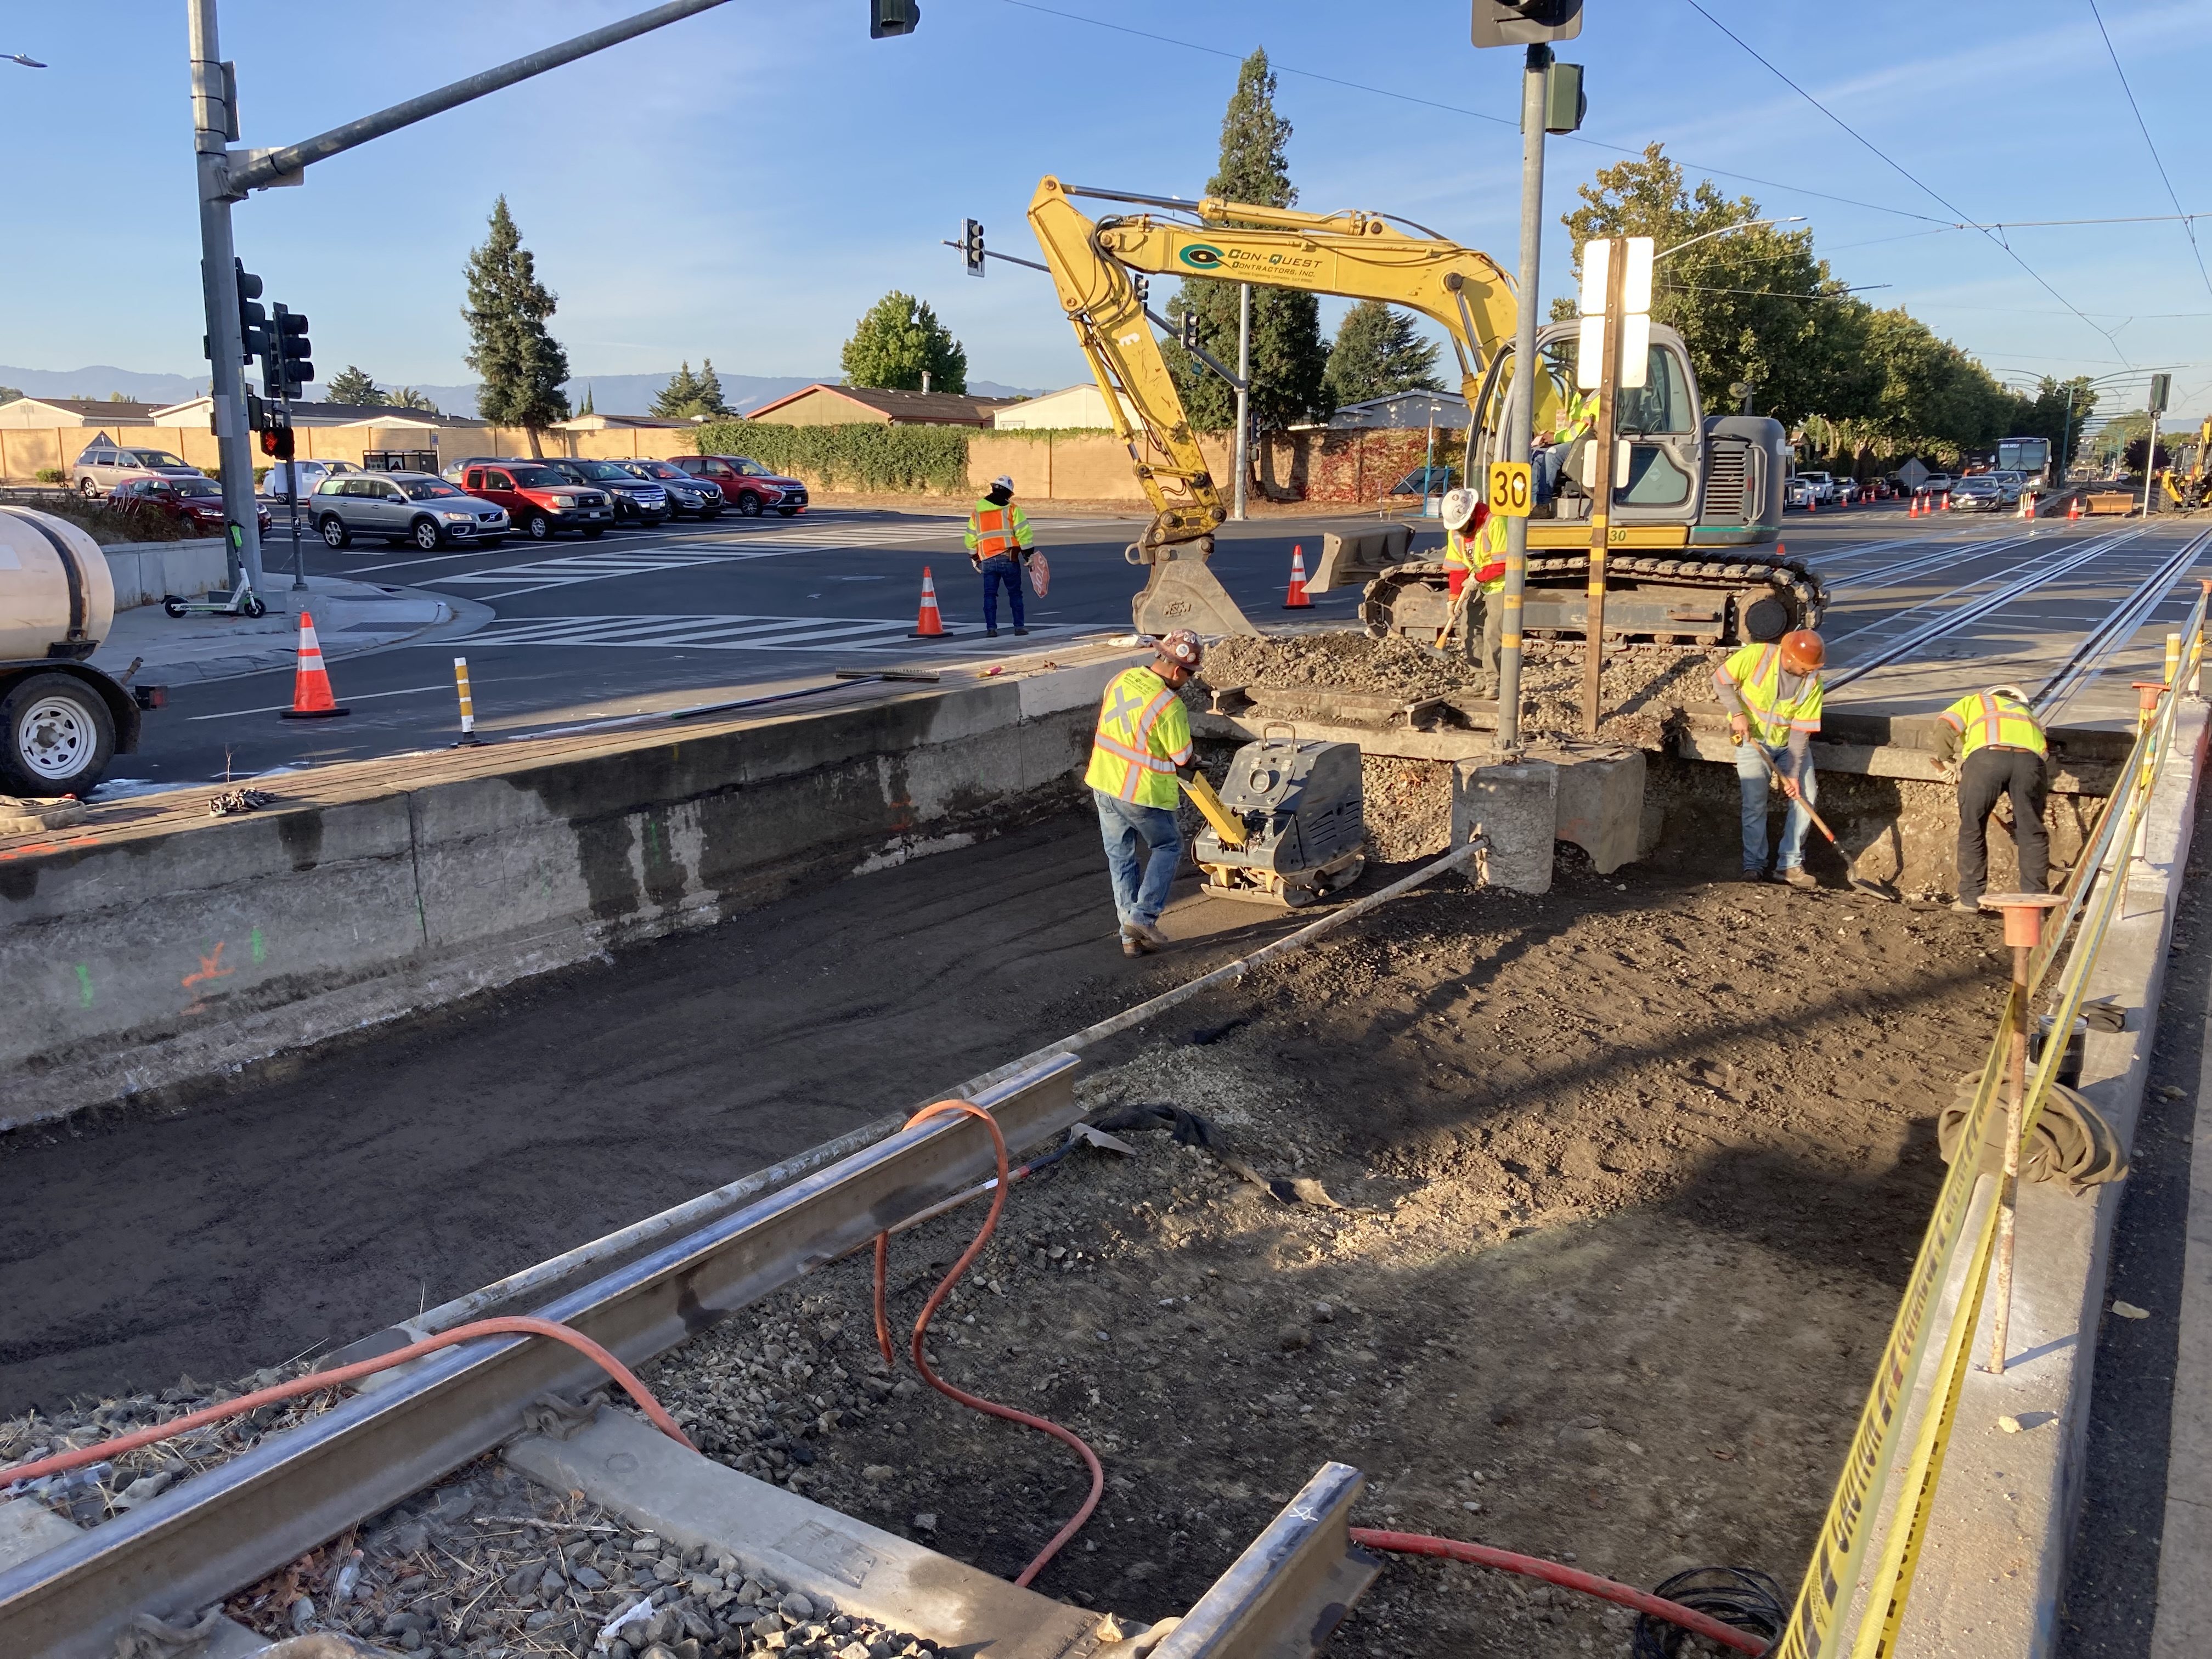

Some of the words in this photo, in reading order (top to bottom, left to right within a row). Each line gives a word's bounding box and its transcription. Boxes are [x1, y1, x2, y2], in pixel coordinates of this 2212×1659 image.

[1227, 249, 1323, 268] CON-QUEST
[1232, 261, 1297, 275] CONTRACTORS,
[1493, 470, 1527, 508] 30
[1831, 1410, 1882, 1553] CAUTION
